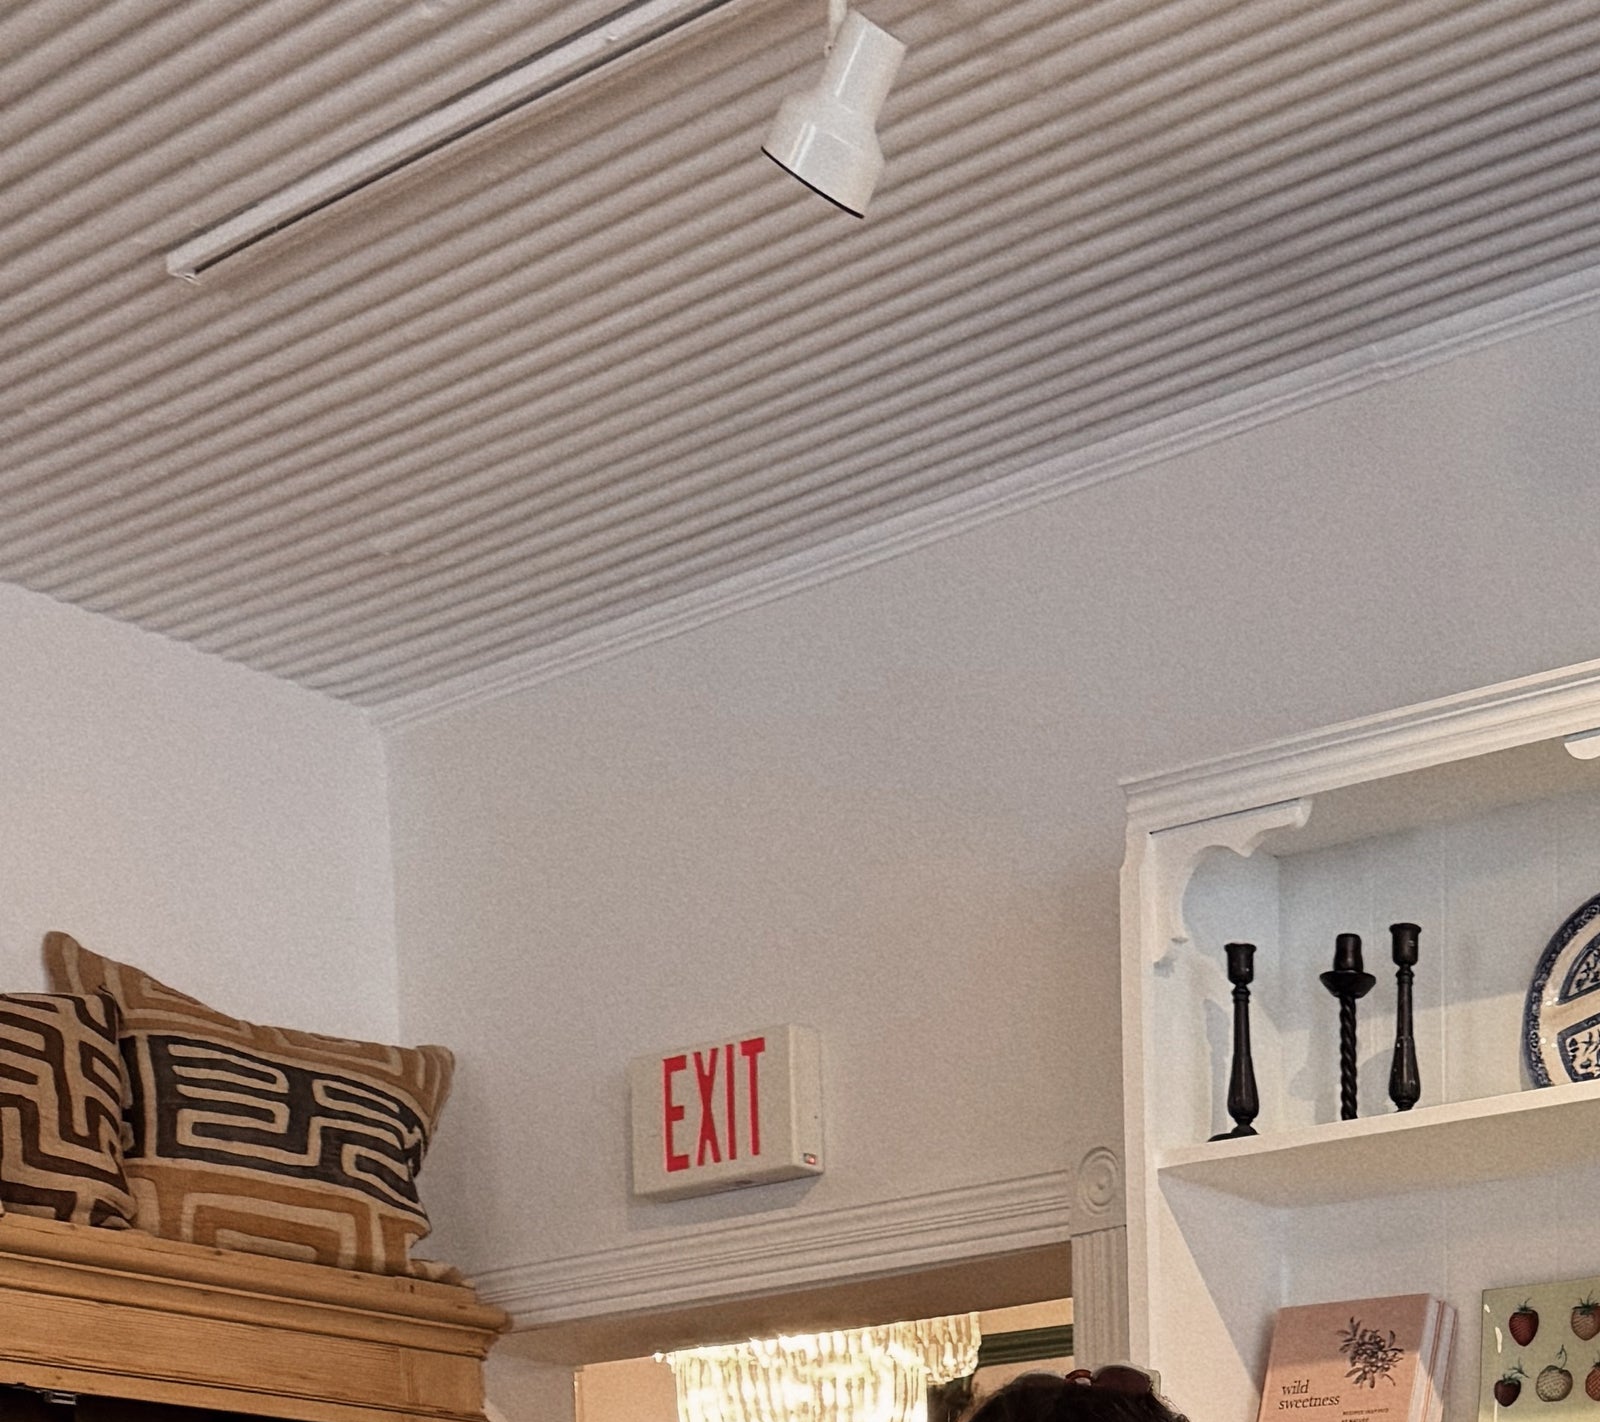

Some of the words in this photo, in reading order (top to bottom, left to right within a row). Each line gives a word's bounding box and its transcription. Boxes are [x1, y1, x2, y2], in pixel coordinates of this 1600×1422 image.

[662, 1037, 766, 1173] EXIT
[1281, 1379, 1310, 1396] wild
[1278, 1395, 1341, 1411] sweetness
